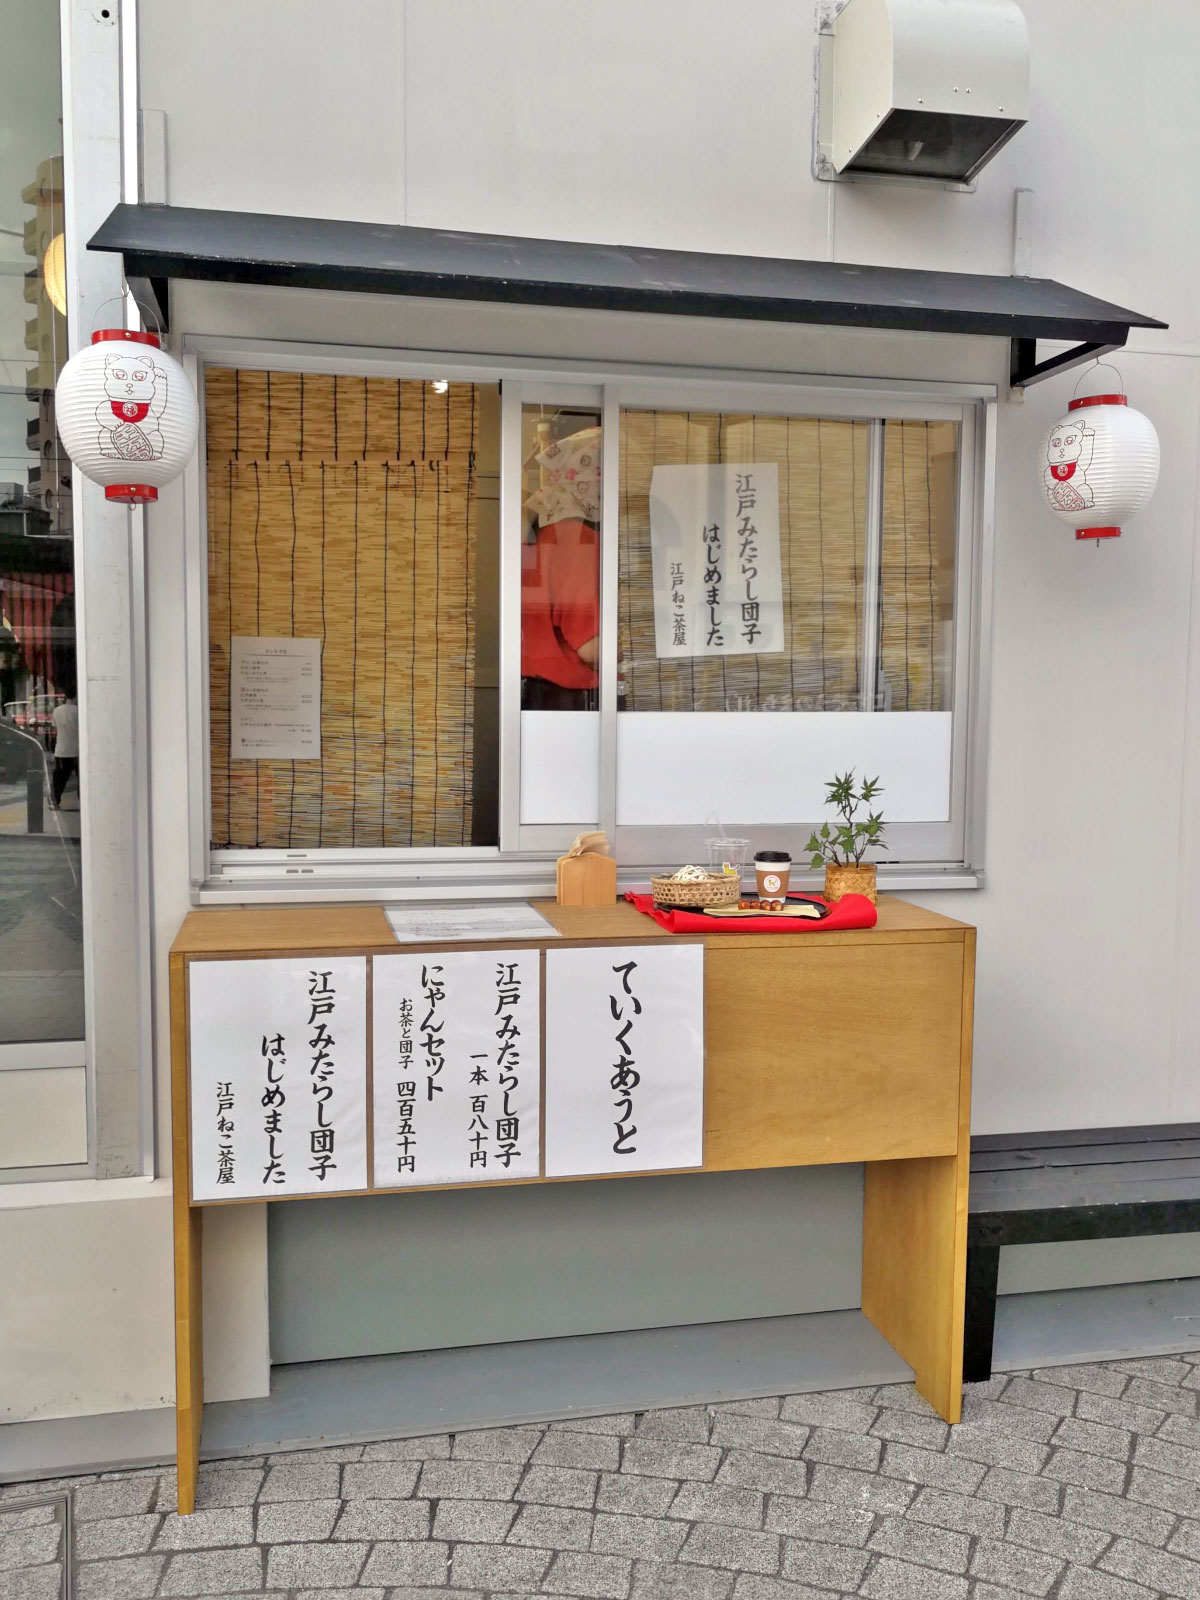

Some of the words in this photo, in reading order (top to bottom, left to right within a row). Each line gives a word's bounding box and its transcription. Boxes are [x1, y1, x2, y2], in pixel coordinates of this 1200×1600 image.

[671, 563, 687, 646] 江戸ねこ茶屋
[703, 524, 724, 646] はじめました
[736, 474, 761, 644] 江戸みたらし団子
[308, 971, 337, 1180] 江戸みたらし団子
[398, 998, 414, 1070] お茶と団子
[419, 965, 445, 1101] にゃんセット
[469, 1054, 489, 1084] 一本
[494, 963, 522, 1168] 江戸みたらし団子
[609, 961, 642, 1155] ていくあうと
[216, 1082, 236, 1185] 江戸ねこ茶屋
[261, 1034, 286, 1184] はじめました
[396, 1081, 417, 1173] 四百五十円
[468, 1095, 489, 1168] 百八十円
